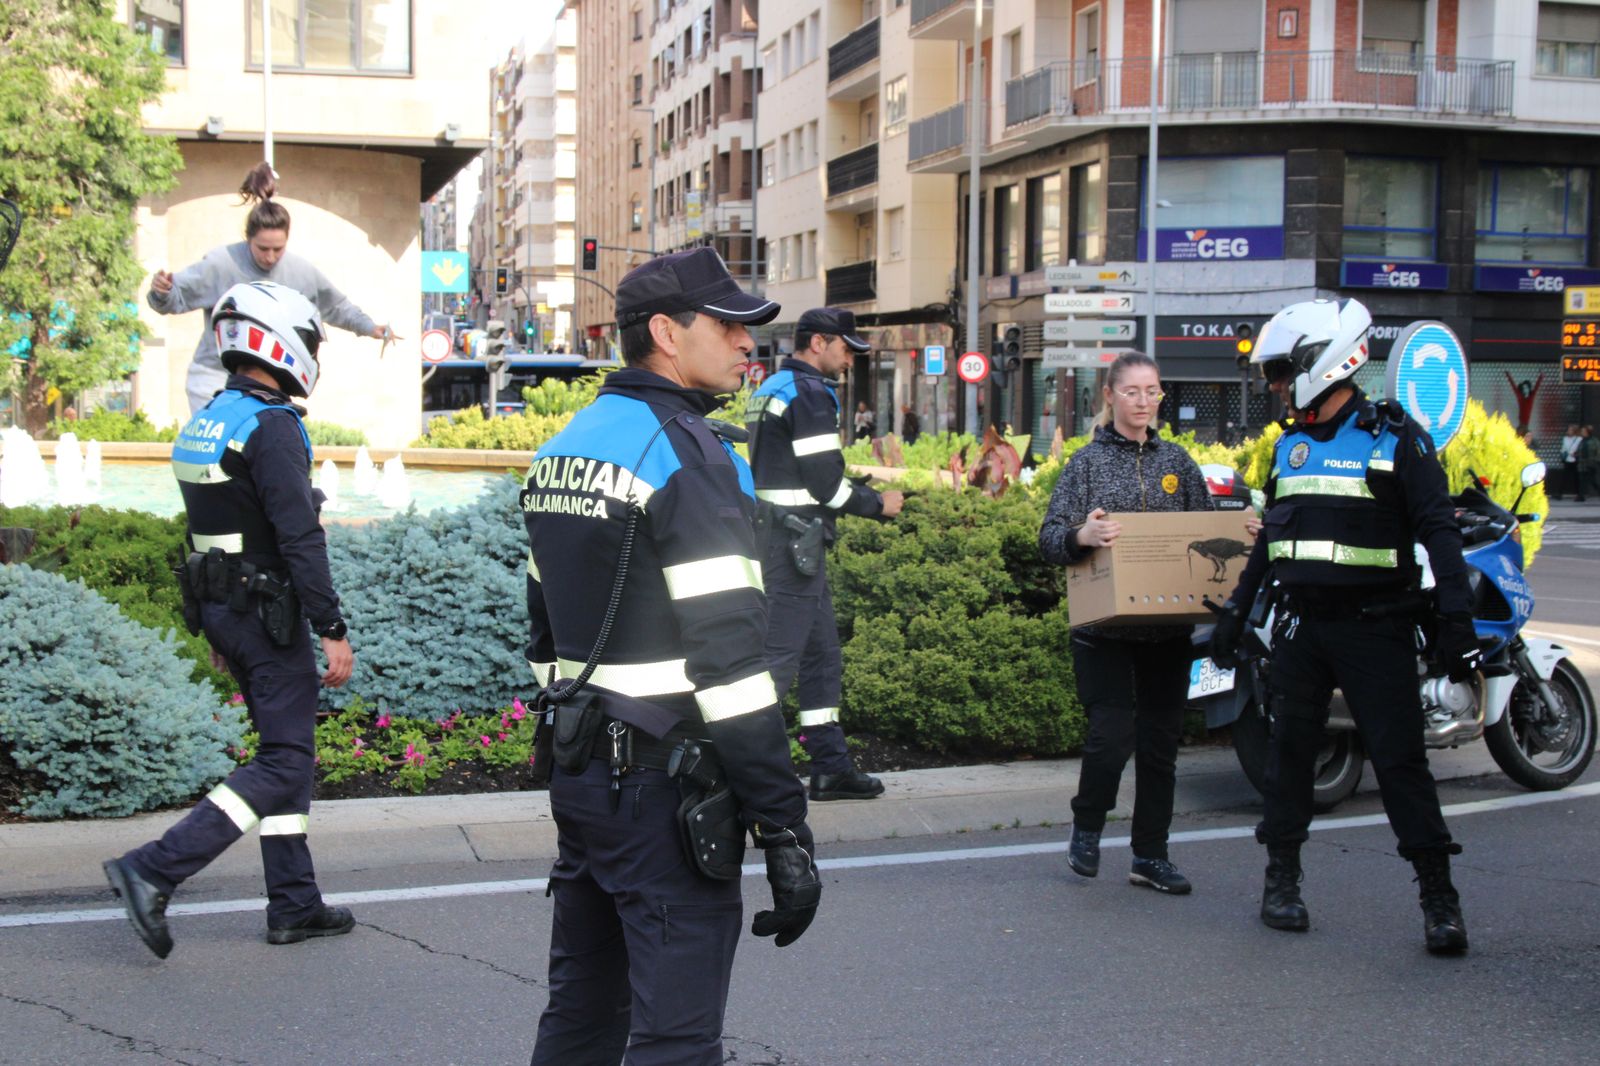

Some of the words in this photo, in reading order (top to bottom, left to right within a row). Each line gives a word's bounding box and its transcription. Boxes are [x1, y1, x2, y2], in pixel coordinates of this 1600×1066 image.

[1197, 238, 1249, 258] CEG
[1048, 272, 1082, 280] LEDESMA
[1388, 271, 1420, 287] CEG
[1534, 276, 1565, 291] CEG
[1048, 299, 1092, 308] VALLADOLID
[1048, 326, 1068, 335] TORO
[1181, 324, 1234, 336] TOKA
[1563, 335, 1573, 346] A
[1047, 353, 1077, 362] ZAMORA
[964, 362, 982, 372] 30
[183, 418, 225, 440] LICIA
[1323, 459, 1362, 470] POLICIA
[523, 456, 614, 496] POLICIA
[523, 494, 609, 519] SALAMANCA
[1512, 596, 1530, 617] 112
